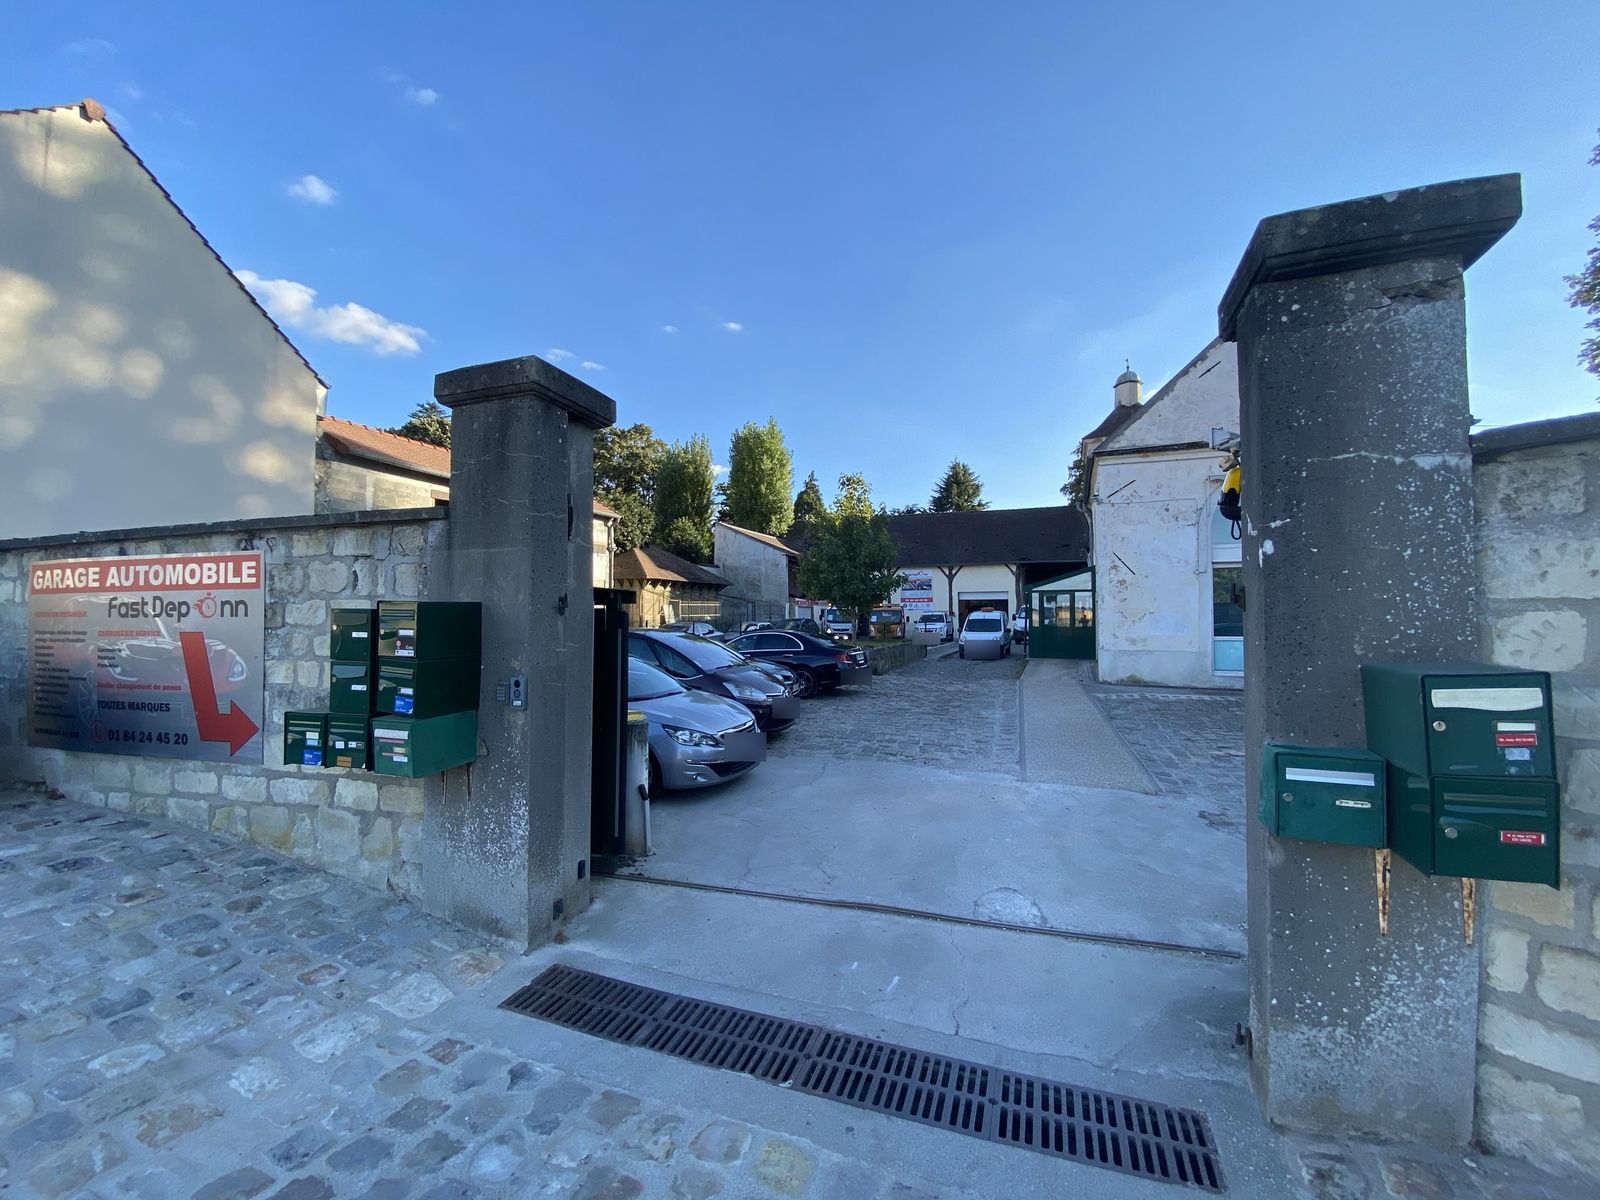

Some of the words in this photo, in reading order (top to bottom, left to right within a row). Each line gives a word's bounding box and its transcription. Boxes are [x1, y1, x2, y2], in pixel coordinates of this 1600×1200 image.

[33, 567, 100, 590] GARAGE
[105, 561, 257, 587] AUTOMOBILE
[97, 701, 126, 711] TOUTES
[127, 701, 171, 713] MARQUES
[108, 732, 121, 742] 01
[123, 732, 137, 743] 84
[138, 732, 152, 744] 24
[156, 733, 171, 745] 45
[173, 733, 189, 746] 20
